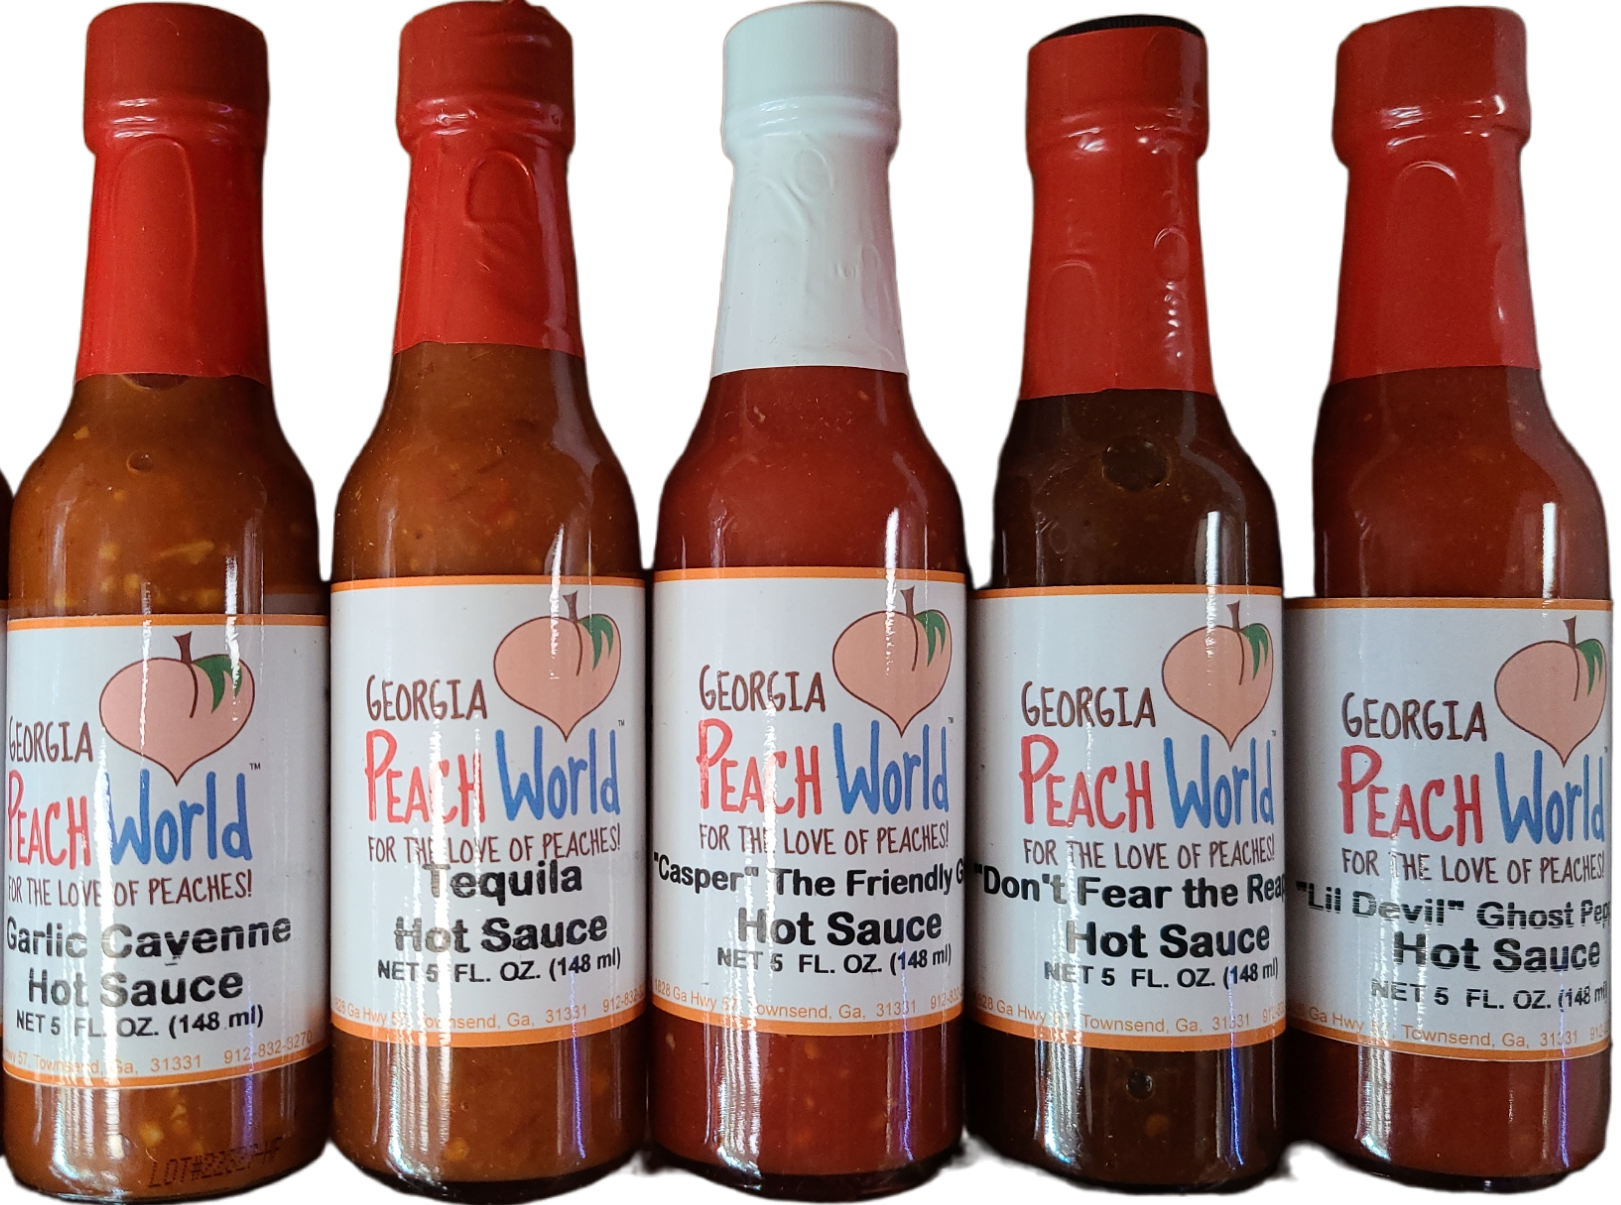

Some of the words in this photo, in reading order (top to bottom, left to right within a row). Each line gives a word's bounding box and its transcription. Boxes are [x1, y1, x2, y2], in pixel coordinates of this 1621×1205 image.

[366, 674, 488, 721] GEORGIA
[699, 665, 826, 712] GEORGIA
[1021, 681, 1156, 728] GEORGIA
[1341, 692, 1487, 742] GEORGIA
[9, 716, 93, 763] GEORGIA
[364, 728, 485, 827] PEACH
[495, 725, 620, 821] World
[696, 718, 822, 818] PEACH
[833, 720, 949, 815] World
[1019, 734, 1154, 833] PEACH
[1163, 734, 1274, 829] World
[1337, 745, 1483, 847] PEACH
[1495, 749, 1605, 845] World
[8, 769, 91, 869] PEACH
[100, 769, 252, 865] World
[699, 824, 729, 850] FOR
[783, 827, 836, 855] LOVE
[844, 828, 869, 854] OF
[877, 820, 949, 853] PEACHES!
[367, 836, 397, 863] FOR
[449, 836, 501, 864] LOVE
[509, 835, 534, 862] OF
[542, 822, 621, 860] PEACHES!
[1023, 838, 1058, 866] FOR
[1066, 840, 1106, 869] THE
[1114, 842, 1170, 870] LOVE
[1178, 842, 1201, 870] OF
[1209, 833, 1275, 868] PEACHES!
[8, 874, 23, 902] FOR
[27, 877, 51, 907] THE
[58, 879, 102, 907] LOVE
[114, 876, 140, 907] OF
[149, 868, 253, 906] PEACHES!
[423, 859, 582, 907] Tequila
[654, 852, 759, 894] "Casper"
[768, 868, 835, 896] The
[847, 863, 953, 896] Friendly
[974, 863, 1067, 904] "Don't
[1077, 876, 1172, 909] Fear
[1182, 877, 1238, 908] the
[1341, 848, 1380, 877] FOR
[1388, 850, 1432, 881] THE
[1441, 855, 1499, 884] LOVE
[1507, 858, 1532, 885] OF
[1540, 850, 1605, 885] PEACHES!
[738, 906, 816, 946] Hot
[826, 911, 943, 946] Sauce
[1296, 881, 1342, 913] "Lil
[1352, 890, 1465, 926] Devil"
[1476, 900, 1574, 929] Ghost
[6, 916, 88, 959] Garlic
[100, 917, 292, 966] Cayenne
[394, 916, 470, 952] Hot
[480, 915, 608, 952] Sauce
[1066, 920, 1148, 958] Hot
[1160, 923, 1270, 958] Sauce
[1394, 931, 1481, 971] Hot
[1493, 937, 1600, 974] Sauce
[377, 959, 419, 982] NET
[426, 964, 438, 982] 5
[454, 964, 491, 983] FL.
[500, 961, 541, 982] OZ.
[549, 954, 591, 982] (148
[597, 947, 621, 970] ml)
[717, 946, 763, 971] NET
[770, 953, 783, 972] 5
[798, 953, 835, 974] FL.
[843, 954, 882, 974] OZ.
[889, 949, 928, 976] (148
[932, 943, 952, 965] ml)
[1044, 961, 1094, 984] NET
[1101, 968, 1115, 986] 5
[1131, 969, 1169, 988] FL.
[1177, 969, 1215, 988] OZ.
[1223, 963, 1259, 990] (148
[1263, 957, 1278, 980] ml)
[28, 967, 89, 1007] Hot
[100, 971, 244, 1008] Sauce
[673, 986, 687, 1002] Ga
[690, 990, 717, 1011] Hwy
[748, 999, 832, 1020] ownsend,
[839, 1004, 866, 1020] Ga,
[876, 999, 917, 1018] 31331
[1371, 979, 1427, 1003] NET
[1434, 987, 1449, 1006] 5
[1466, 988, 1504, 1009] FL.
[1513, 990, 1551, 1009] OZ.
[1558, 985, 1591, 1012] (148
[16, 1009, 46, 1034] NET
[50, 1016, 61, 1036] 5
[116, 1017, 159, 1038] OZ.
[168, 1012, 220, 1039] (148
[228, 1004, 264, 1028] ml)
[348, 1003, 360, 1018] Ga
[363, 1007, 387, 1028] Hwy
[421, 1009, 500, 1031] onsend,
[507, 1012, 534, 1028] Ga,
[546, 1004, 587, 1024] 31331
[997, 1000, 1013, 1016] Ga
[1018, 1004, 1047, 1025] Hwy
[1081, 1013, 1169, 1034] Townsend,
[1175, 1018, 1202, 1033] Ga,
[1212, 1013, 1249, 1031] 31331
[1309, 1006, 1327, 1023] Ga
[1332, 1012, 1364, 1032] Hwy
[1401, 1024, 1495, 1048] Townsend,
[1502, 1032, 1529, 1048] Ga,
[1540, 1030, 1578, 1047] 31331
[150, 1054, 201, 1073] 31331
[224, 1029, 313, 1065] 912-832-3270
